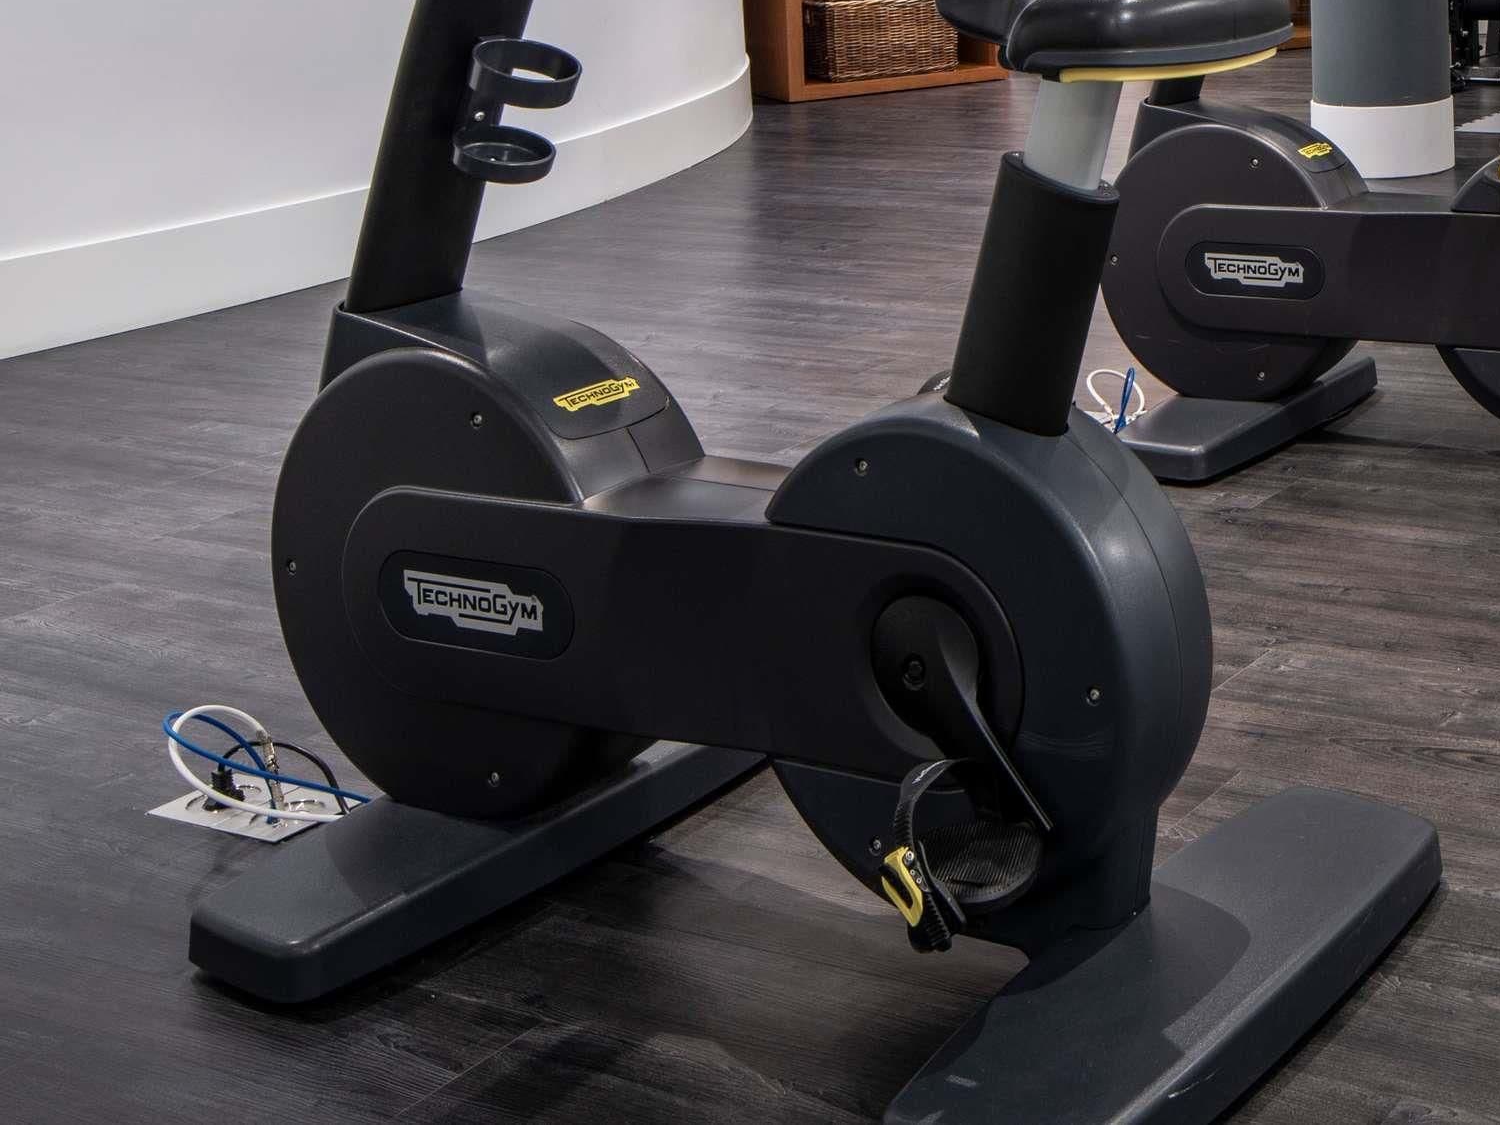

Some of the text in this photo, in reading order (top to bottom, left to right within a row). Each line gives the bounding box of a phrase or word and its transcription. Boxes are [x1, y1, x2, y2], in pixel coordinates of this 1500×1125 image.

[1207, 257, 1300, 281] TECHNOGYM
[558, 381, 635, 407] TECHNOGYM
[407, 577, 538, 625] TECHNOGYM
